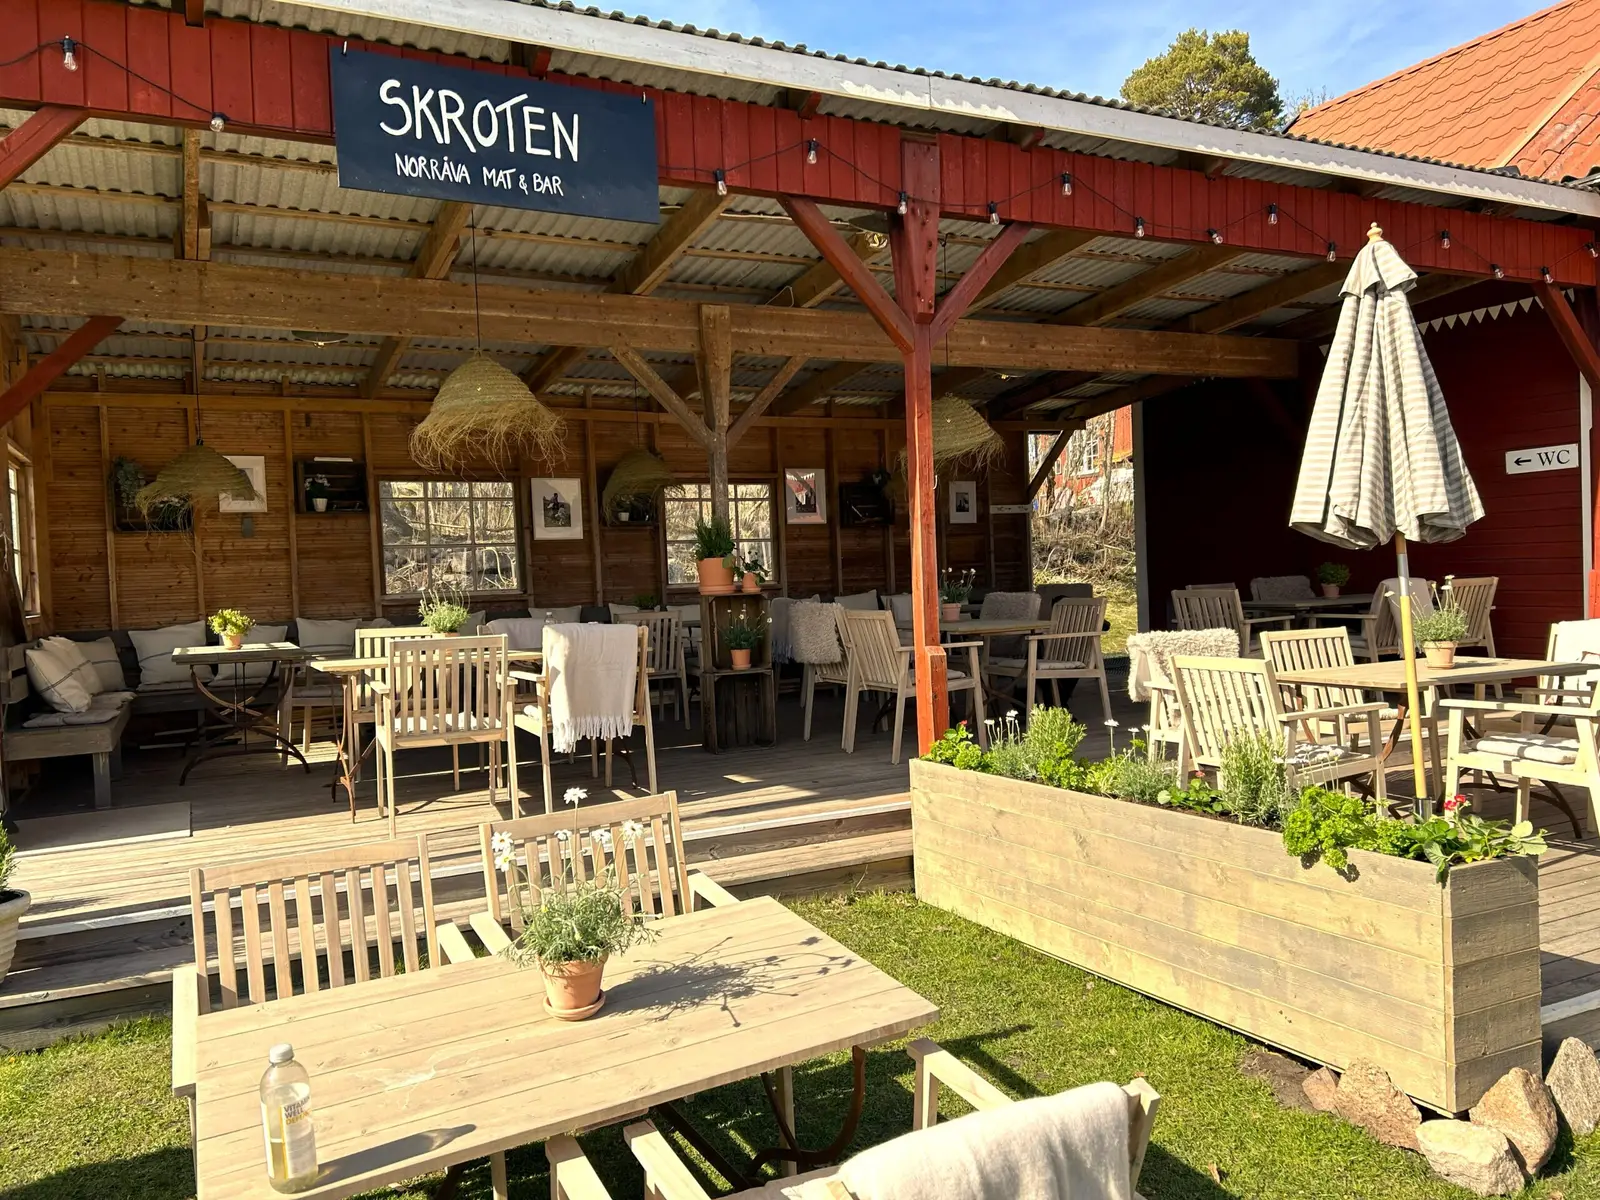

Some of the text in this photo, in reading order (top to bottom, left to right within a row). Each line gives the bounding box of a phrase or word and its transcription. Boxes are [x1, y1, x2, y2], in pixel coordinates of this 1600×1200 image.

[379, 78, 579, 162] SKROTEN
[394, 152, 564, 197] NORRÅVA MAT & BAR
[1536, 449, 1570, 466] WC
[283, 1095, 310, 1113] VITAM
[284, 1107, 304, 1119] WELL
